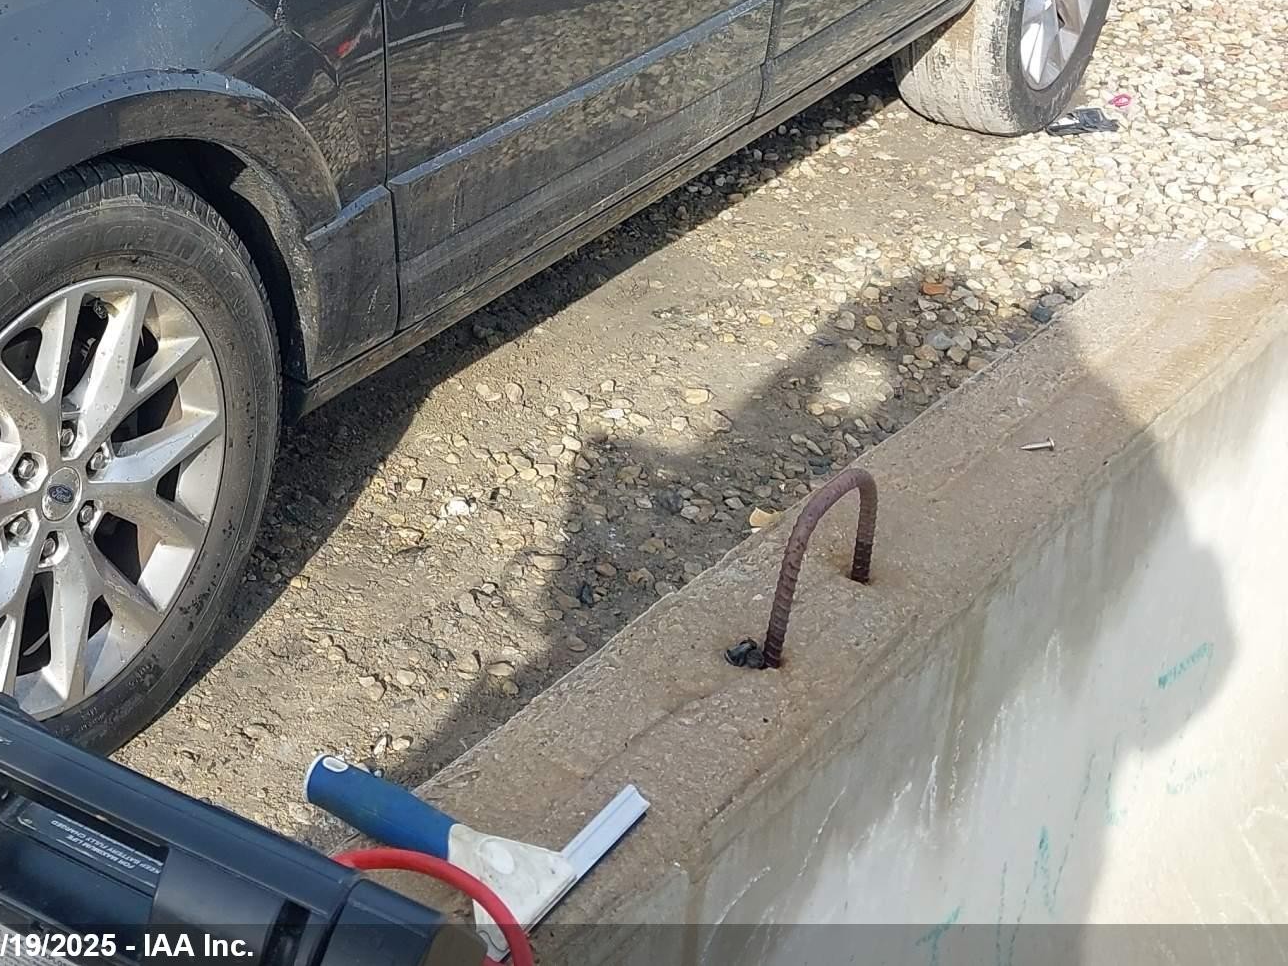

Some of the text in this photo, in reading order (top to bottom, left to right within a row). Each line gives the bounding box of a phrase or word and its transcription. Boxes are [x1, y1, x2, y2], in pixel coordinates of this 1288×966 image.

[50, 819, 86, 838] CHARGED
[82, 842, 118, 862] MAXIMUM
[85, 837, 109, 850] FULLY
[107, 847, 142, 865] BATTERY
[117, 859, 136, 869] FOR
